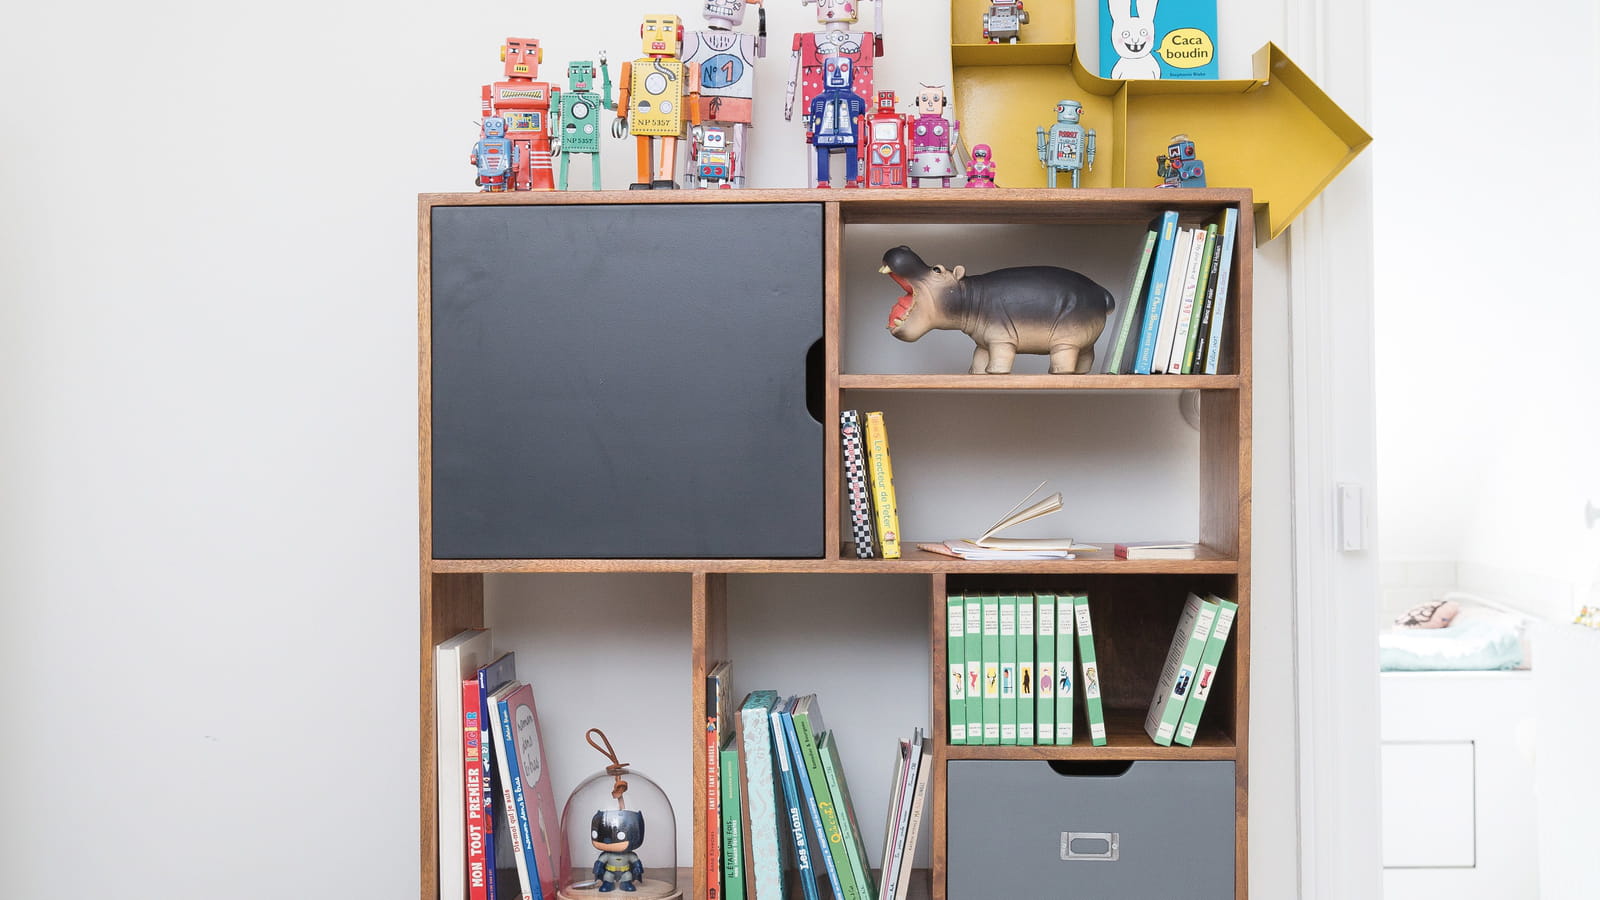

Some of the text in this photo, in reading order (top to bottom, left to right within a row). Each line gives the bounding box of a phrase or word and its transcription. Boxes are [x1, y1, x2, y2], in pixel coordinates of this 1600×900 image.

[1172, 35, 1203, 45] Caca
[1166, 48, 1208, 58] boudin
[721, 60, 734, 82] 1
[873, 439, 883, 451] Le
[874, 452, 888, 489] tracteur
[879, 490, 889, 501] de
[881, 503, 893, 528] Peter
[503, 788, 521, 853] Dis-moi qui je suis
[469, 824, 482, 854] TOUT
[788, 806, 809, 870] Les avions
[725, 851, 734, 869] ÉTAIT
[470, 861, 483, 887] MON
